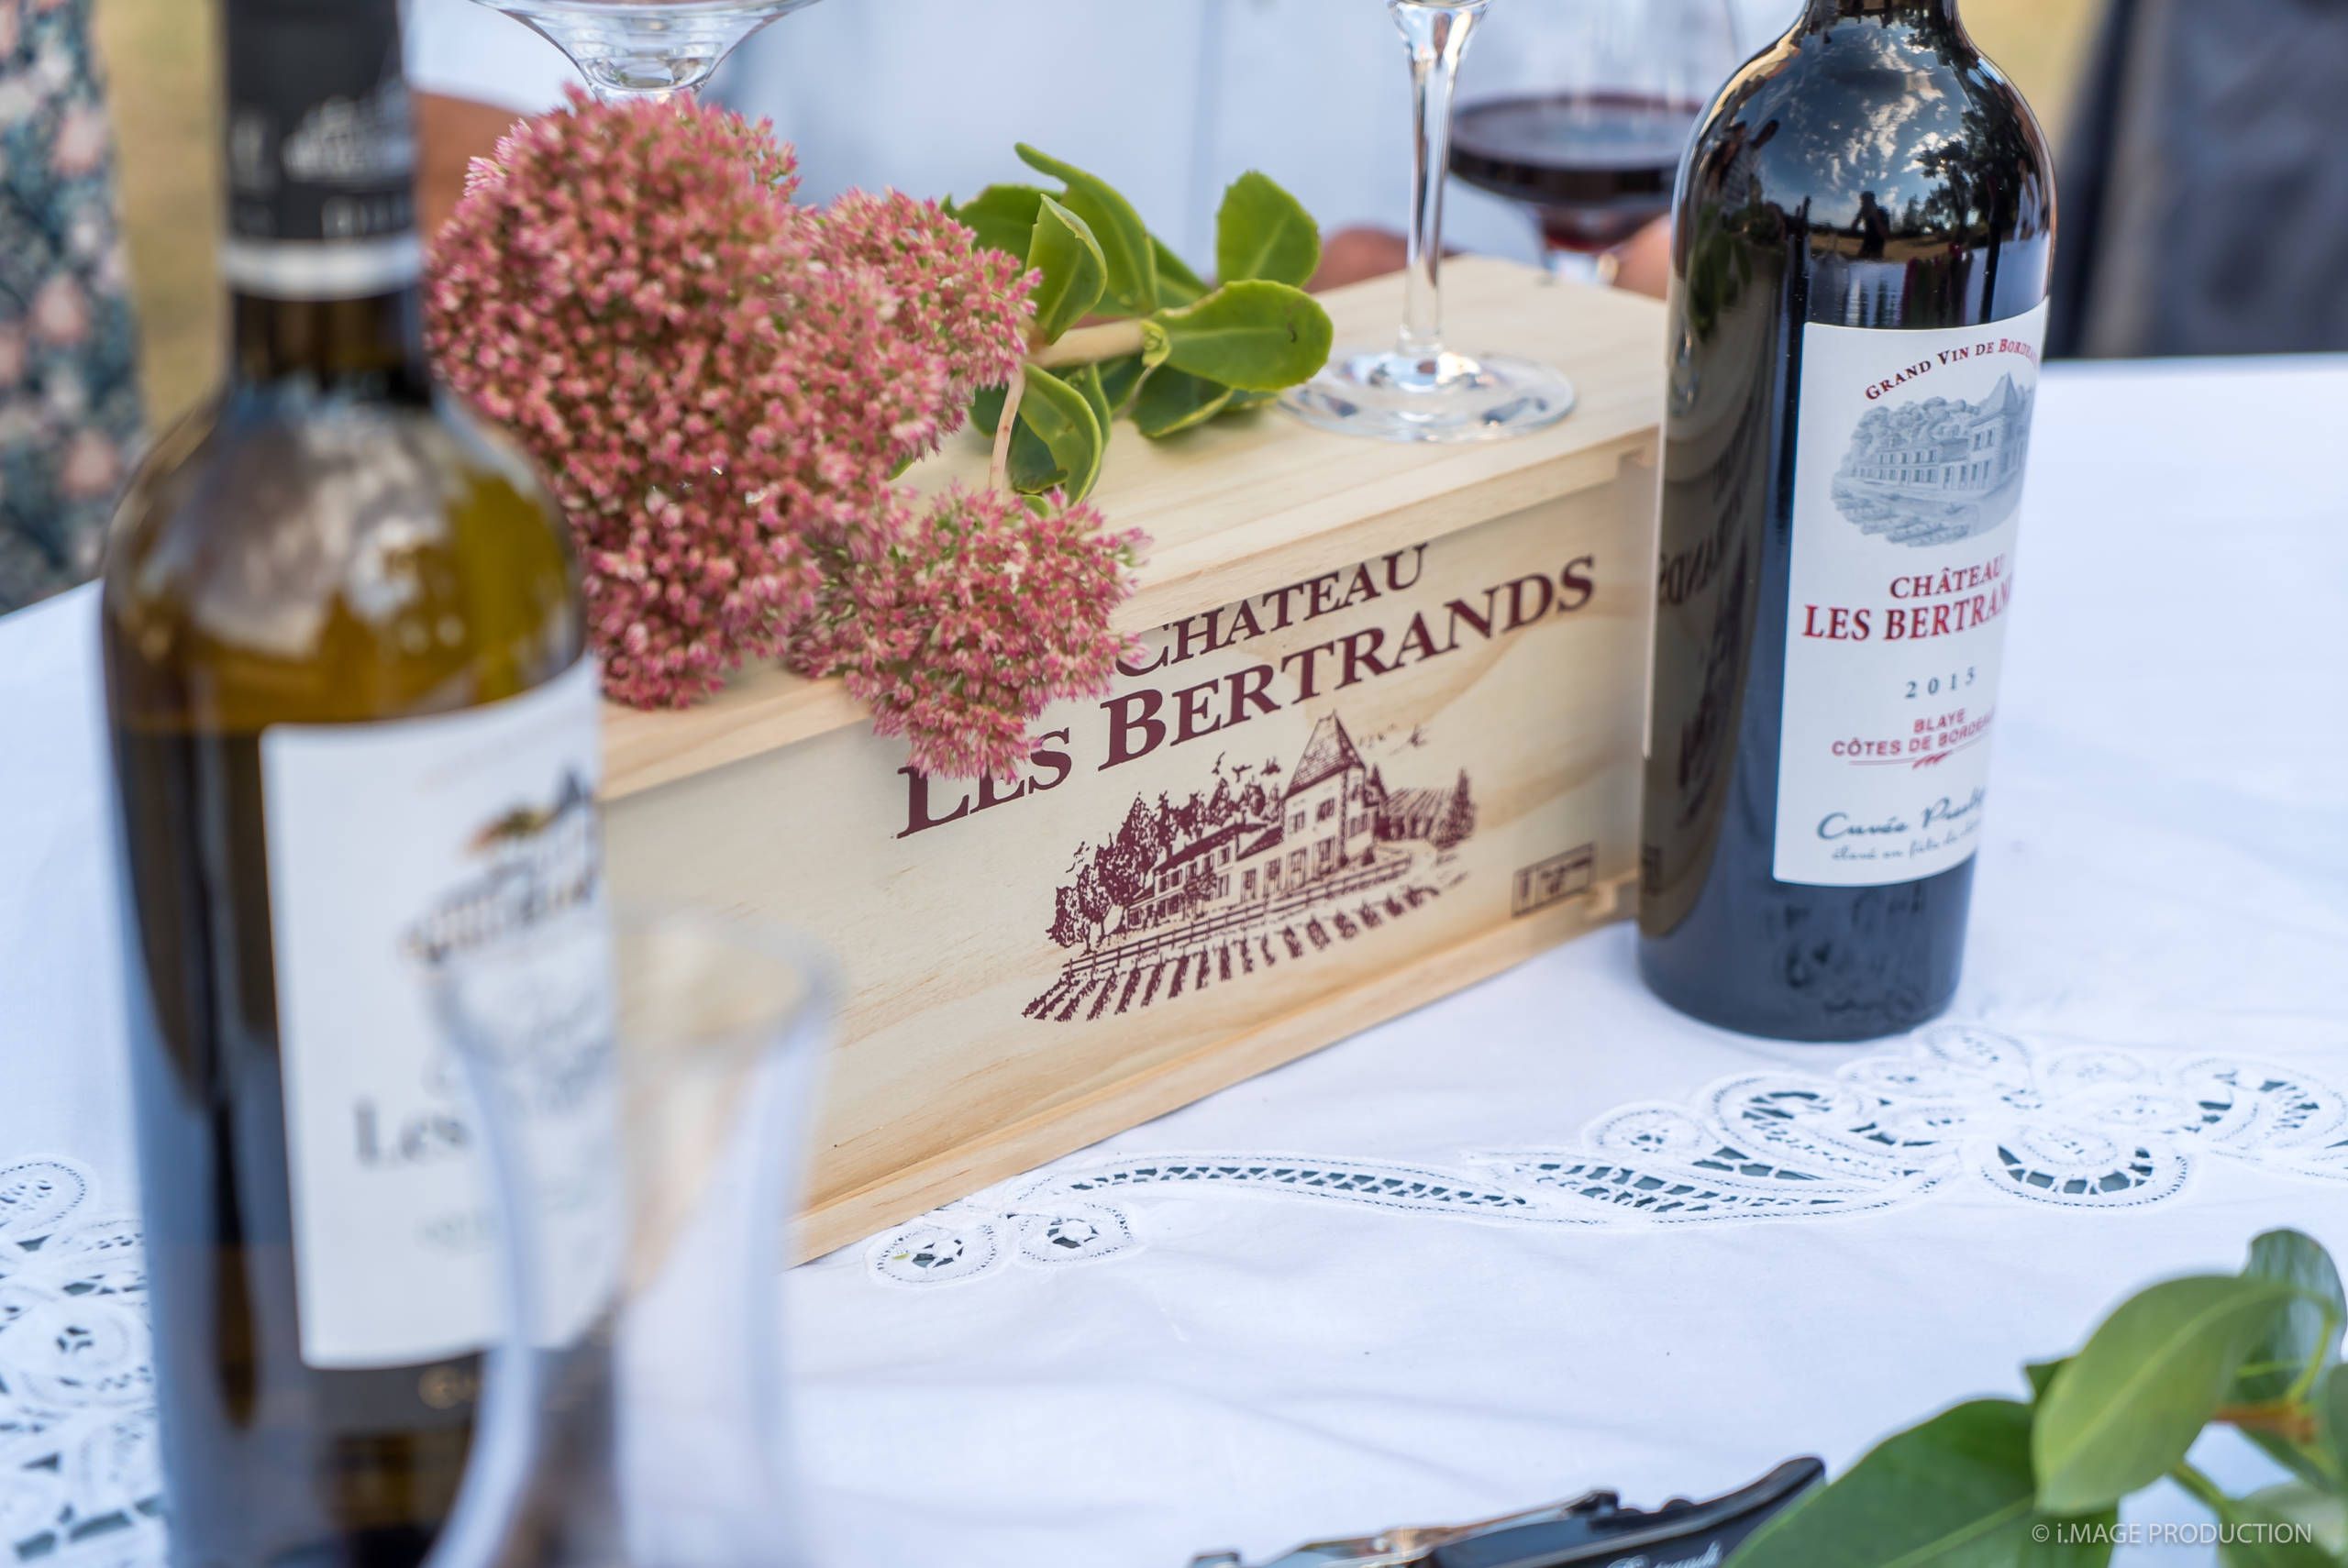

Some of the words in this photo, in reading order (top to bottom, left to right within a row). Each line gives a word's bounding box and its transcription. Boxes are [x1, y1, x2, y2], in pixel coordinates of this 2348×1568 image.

[1865, 359, 1932, 400] GRAND
[1937, 347, 1970, 365] VIN
[1975, 342, 1994, 356] DE
[1889, 552, 2006, 600] CHÂTEAU
[1802, 604, 1871, 641] LES
[1097, 555, 1594, 771] BERTRANDS
[1913, 708, 1966, 734] BLAYE
[1832, 736, 1900, 756] CÔTES
[1909, 734, 1932, 753] DE
